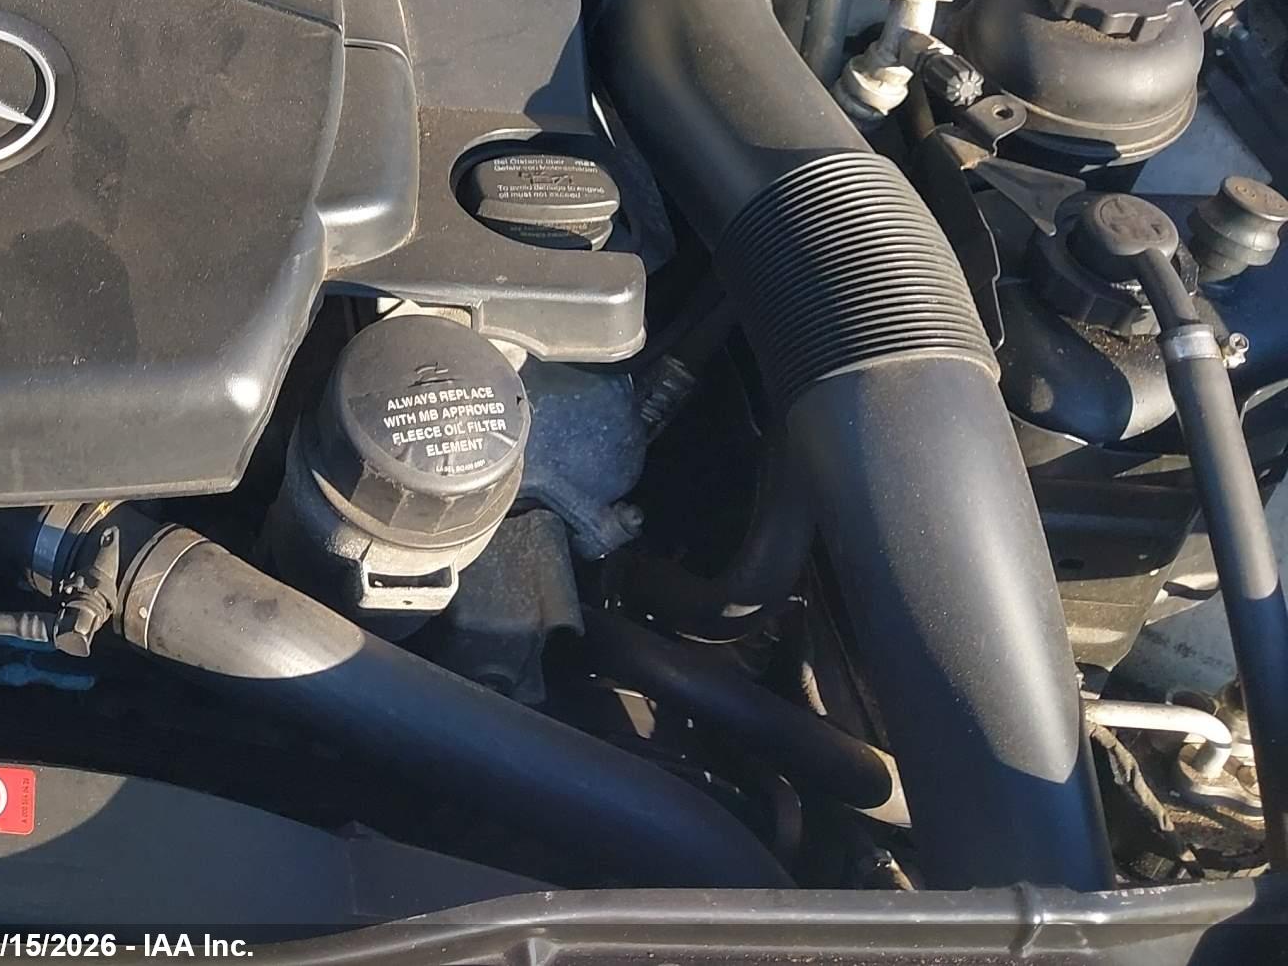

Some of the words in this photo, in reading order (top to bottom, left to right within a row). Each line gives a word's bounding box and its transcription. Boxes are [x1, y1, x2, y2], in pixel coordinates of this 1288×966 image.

[387, 391, 438, 411] ALWAYS
[439, 386, 495, 403] REPLACE
[383, 412, 417, 429] WITH
[418, 409, 439, 423] MB
[442, 402, 505, 419] APPROVED
[392, 425, 443, 445] FLEECE
[444, 422, 466, 436] OIL
[467, 418, 507, 434] FILTER
[425, 437, 484, 457] ELEMENT
